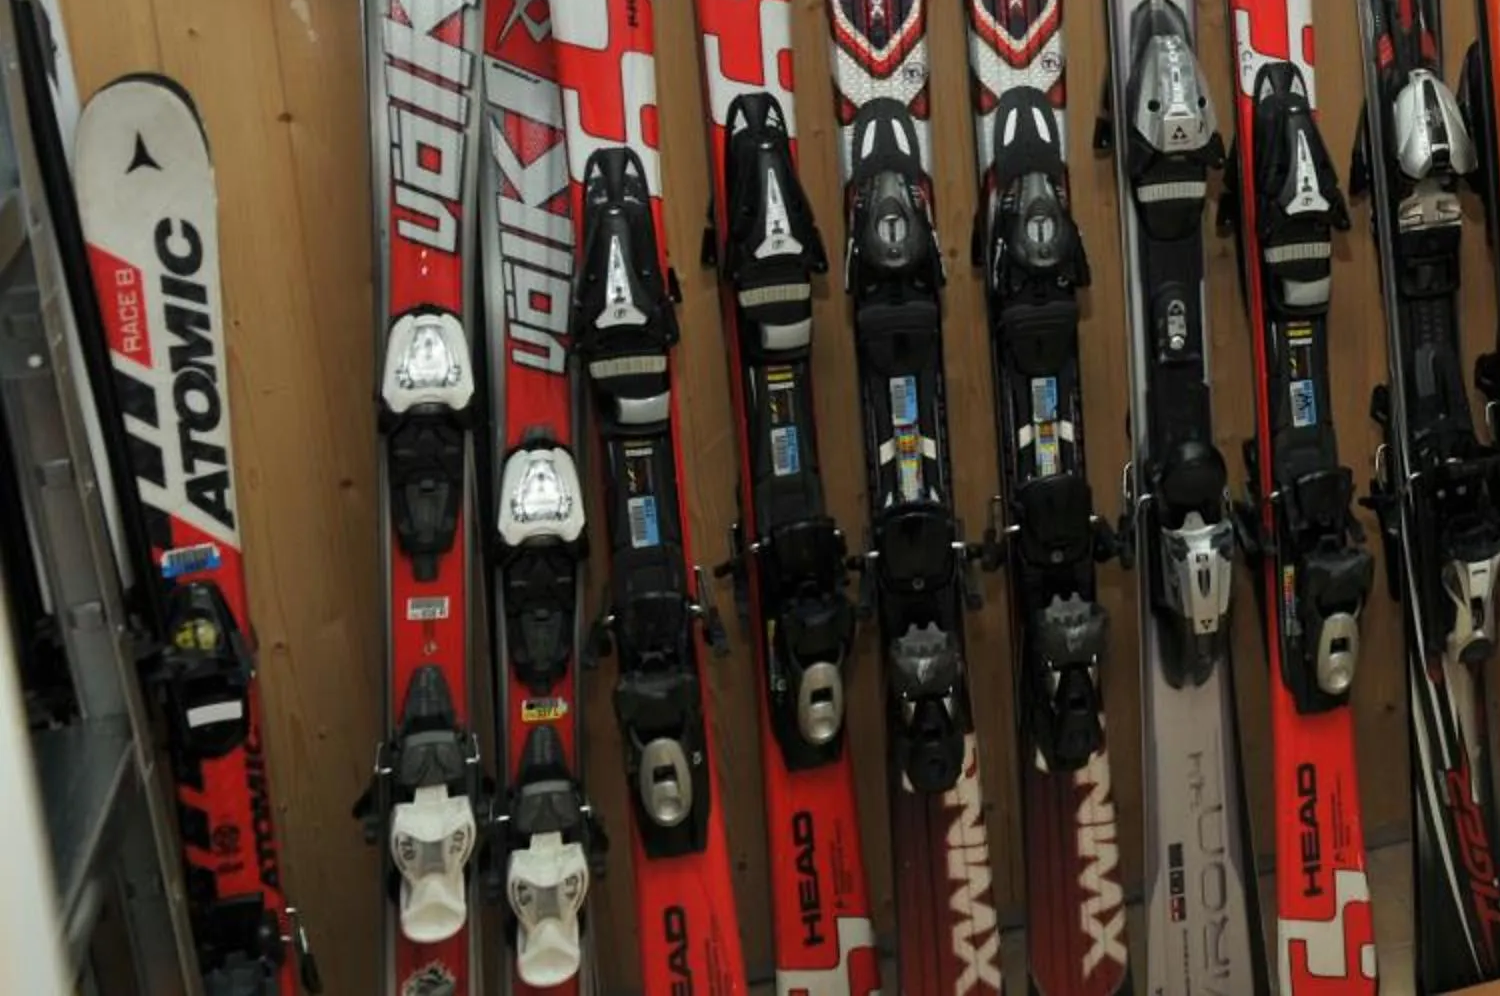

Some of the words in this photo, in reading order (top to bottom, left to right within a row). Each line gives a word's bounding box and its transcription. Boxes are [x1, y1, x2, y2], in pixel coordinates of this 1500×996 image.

[118, 293, 142, 354] RACE
[154, 217, 235, 531] ATOMIC
[792, 811, 825, 947] HEAD
[1073, 752, 1128, 980] XWIN
[1297, 763, 1322, 897] HEAD
[663, 905, 694, 996] EAD
